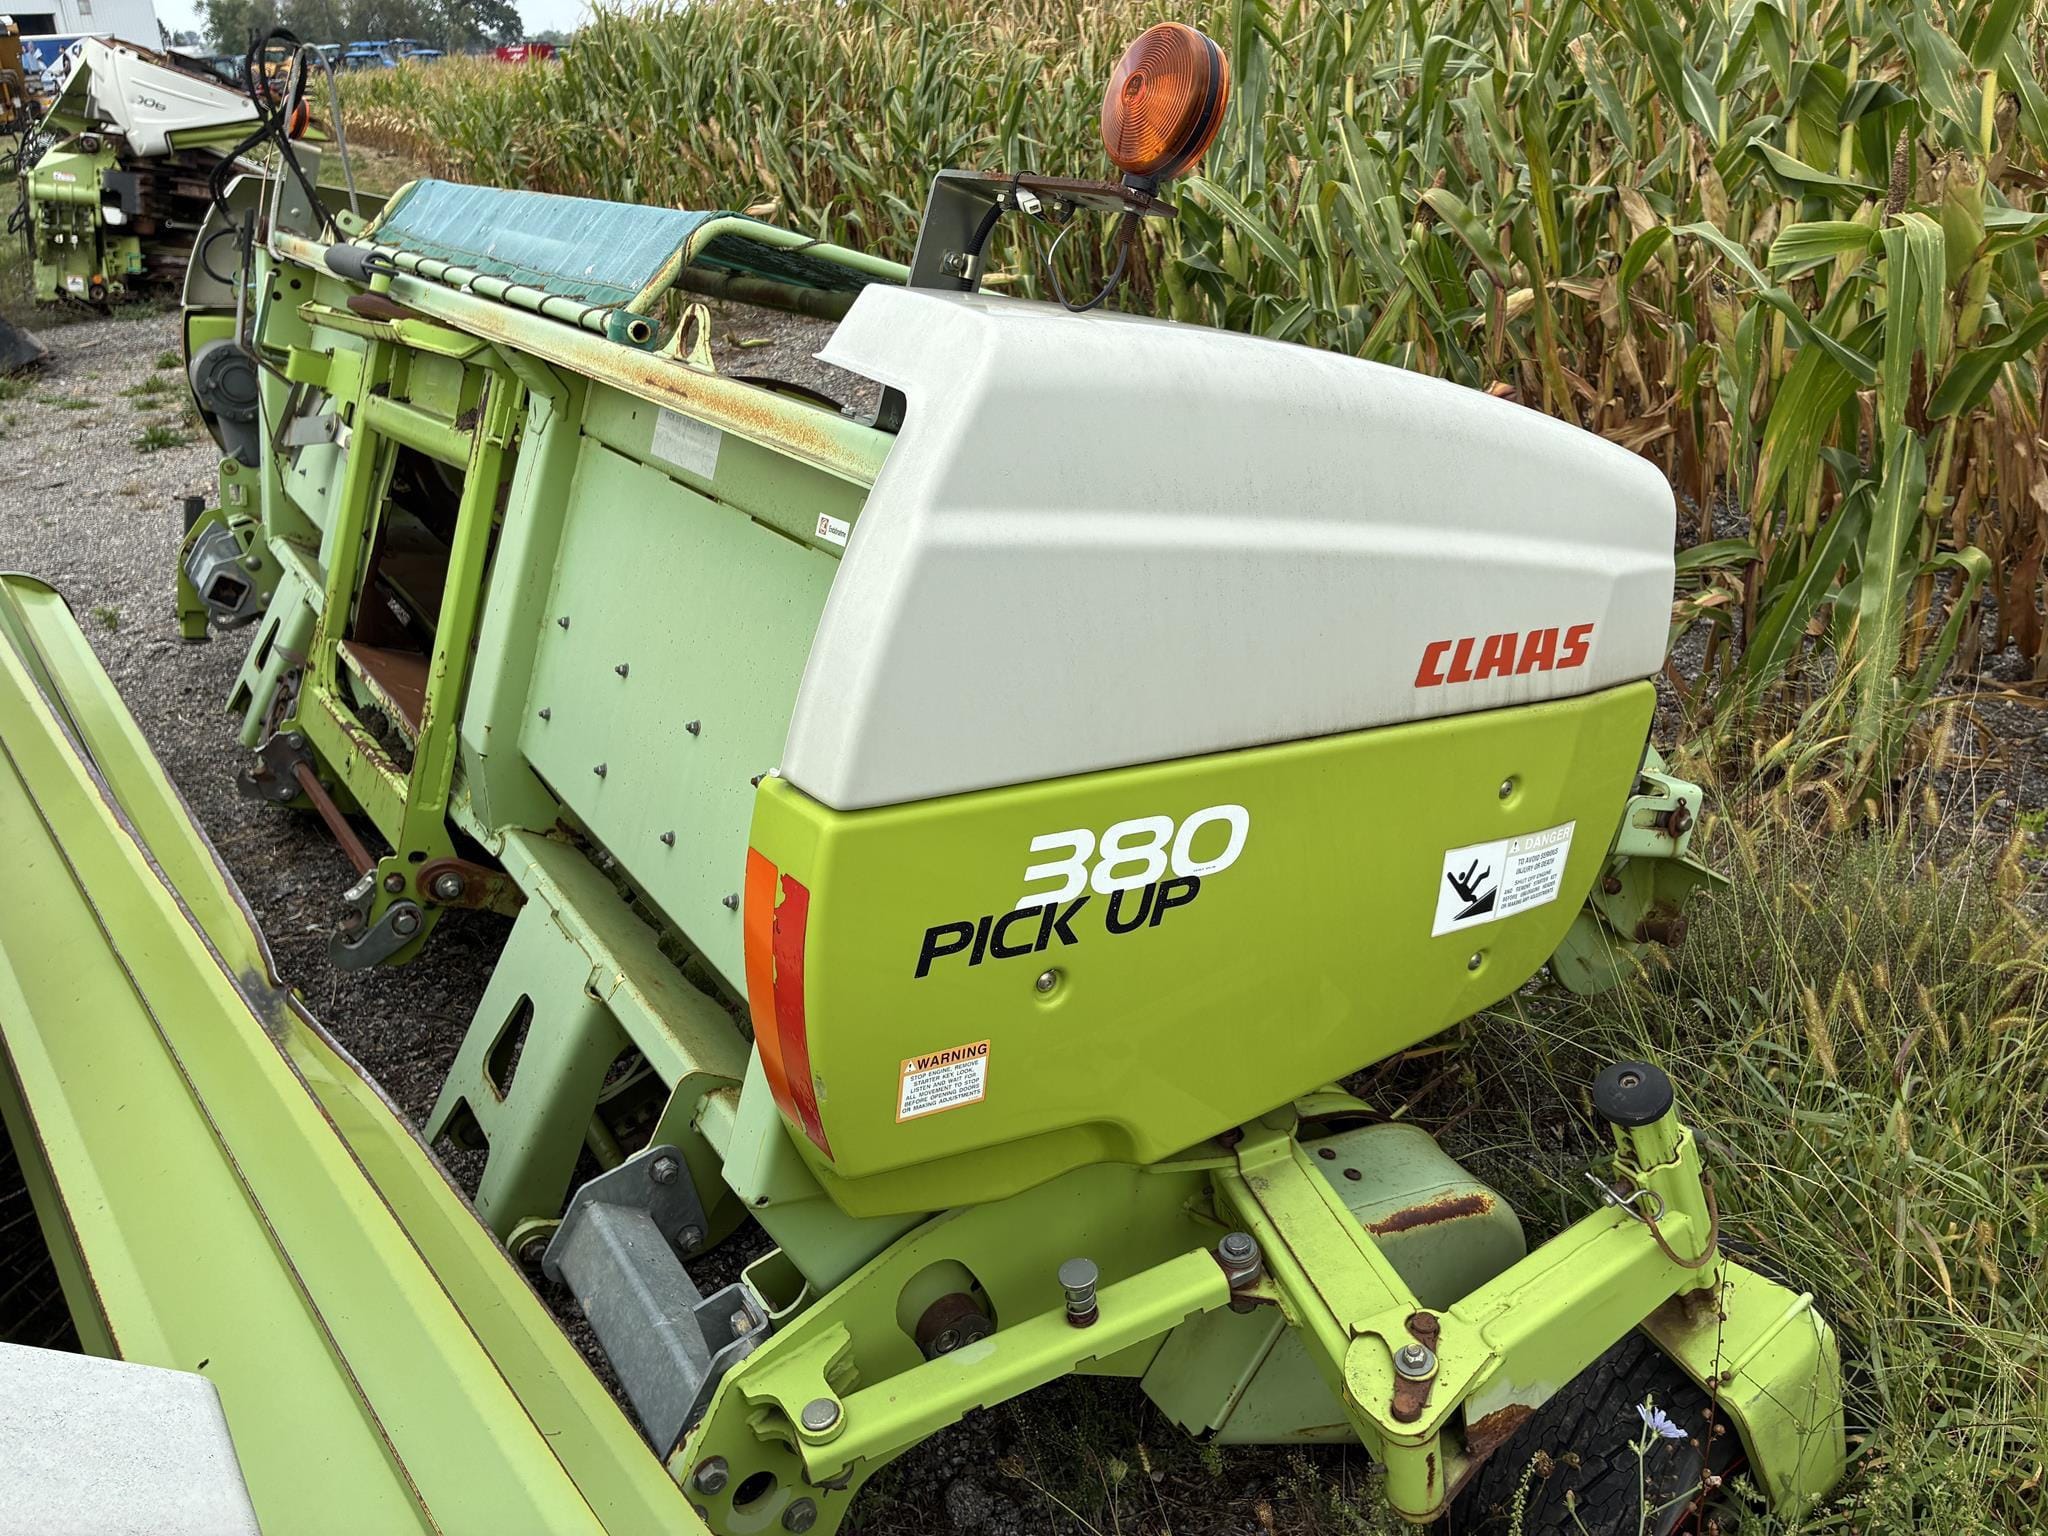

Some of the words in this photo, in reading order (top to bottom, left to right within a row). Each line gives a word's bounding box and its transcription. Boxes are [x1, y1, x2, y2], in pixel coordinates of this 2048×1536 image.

[1414, 623, 1594, 688] CLAAS
[1525, 827, 1570, 850] DANGER
[1014, 804, 1250, 911] 380
[1525, 855, 1540, 864] AVOID
[914, 895, 1092, 979] PICK
[1105, 875, 1201, 935] UP
[917, 1043, 987, 1070] WARNING
[910, 1073, 926, 1081] STOP
[955, 1060, 979, 1070] REMOVE
[913, 1075, 940, 1086] STARTER
[904, 1098, 928, 1107] BEFORE
[930, 1090, 957, 1100] OPENING
[959, 1084, 980, 1093] DOORS
[910, 1084, 931, 1093] LISTEN
[933, 1080, 945, 1088] AND
[948, 1075, 962, 1084] WAIT
[918, 1084, 952, 1097] MOVEMENT
[964, 1077, 980, 1085] STOP
[902, 1106, 911, 1114] OR
[913, 1101, 937, 1111] MAKING
[938, 1089, 981, 1103] ADJUSTMENTS
